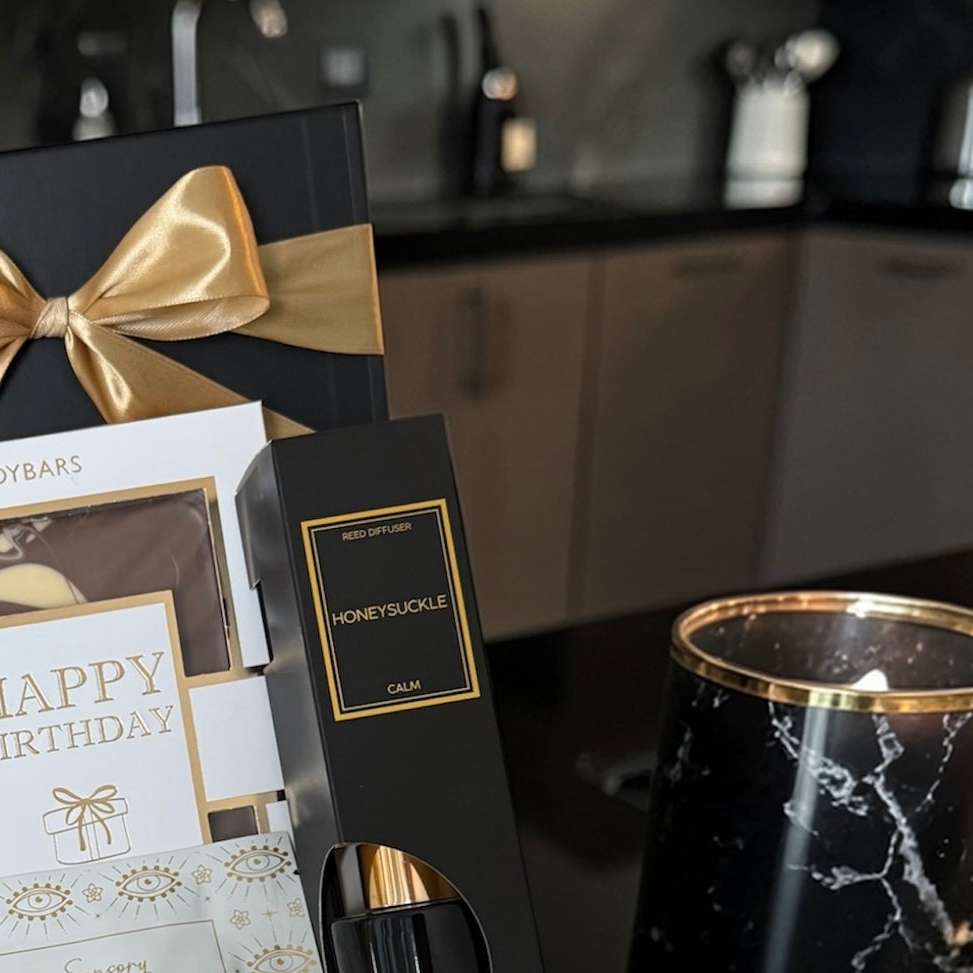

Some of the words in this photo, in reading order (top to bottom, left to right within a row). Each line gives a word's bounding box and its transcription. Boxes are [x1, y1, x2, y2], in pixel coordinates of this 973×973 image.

[341, 530, 367, 542] REED
[368, 522, 412, 538] DIFFUSER
[332, 594, 448, 626] HONEYSUCKLE
[386, 679, 422, 695] CALM
